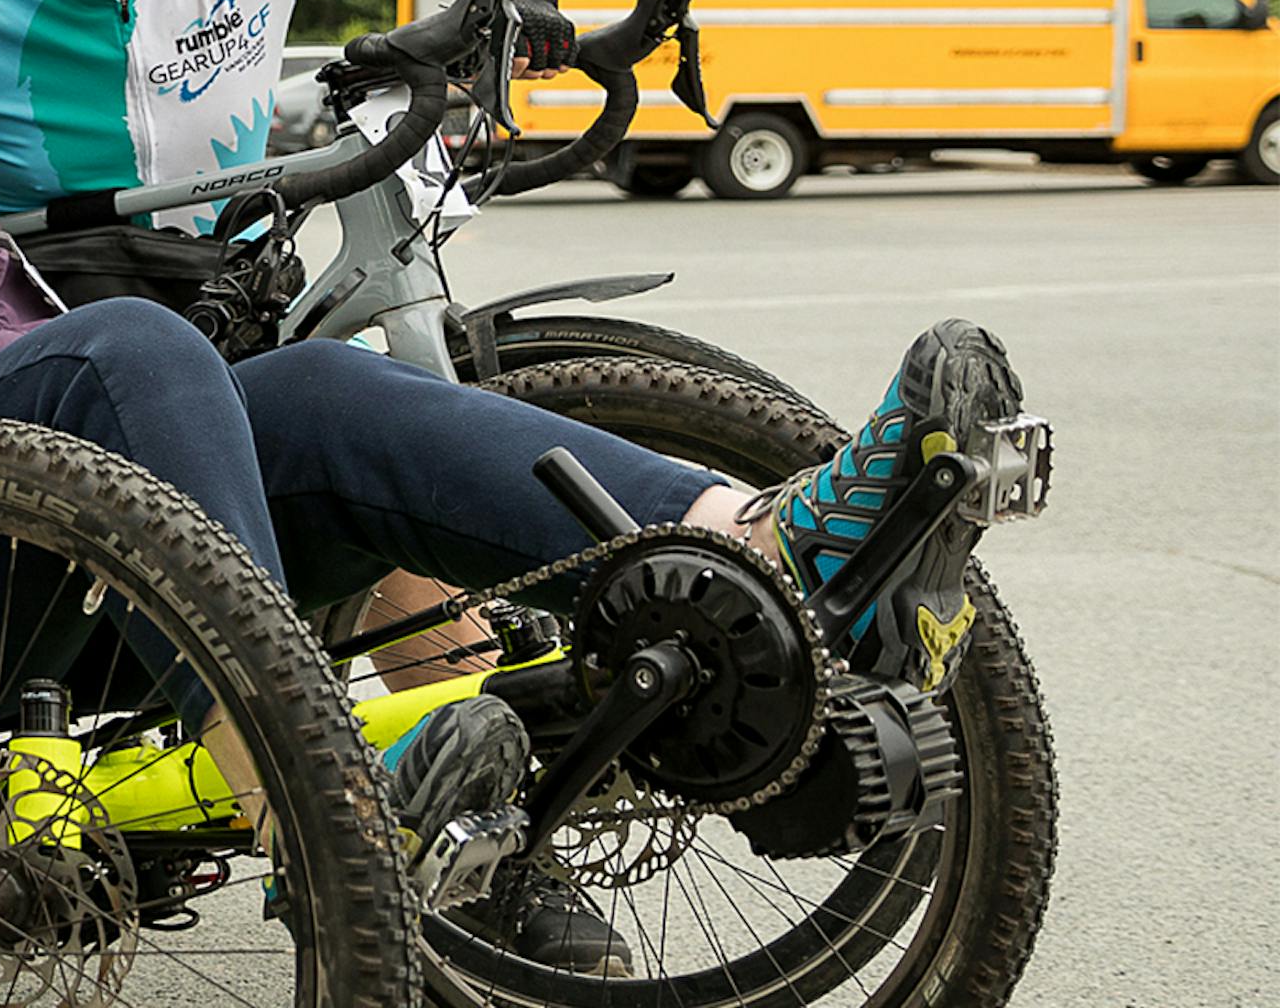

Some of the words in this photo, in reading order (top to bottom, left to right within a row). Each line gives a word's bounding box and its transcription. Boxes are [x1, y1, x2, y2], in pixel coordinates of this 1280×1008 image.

[175, 10, 244, 55] rumble
[191, 165, 285, 195] NORCO
[544, 330, 640, 348] MARATHON
